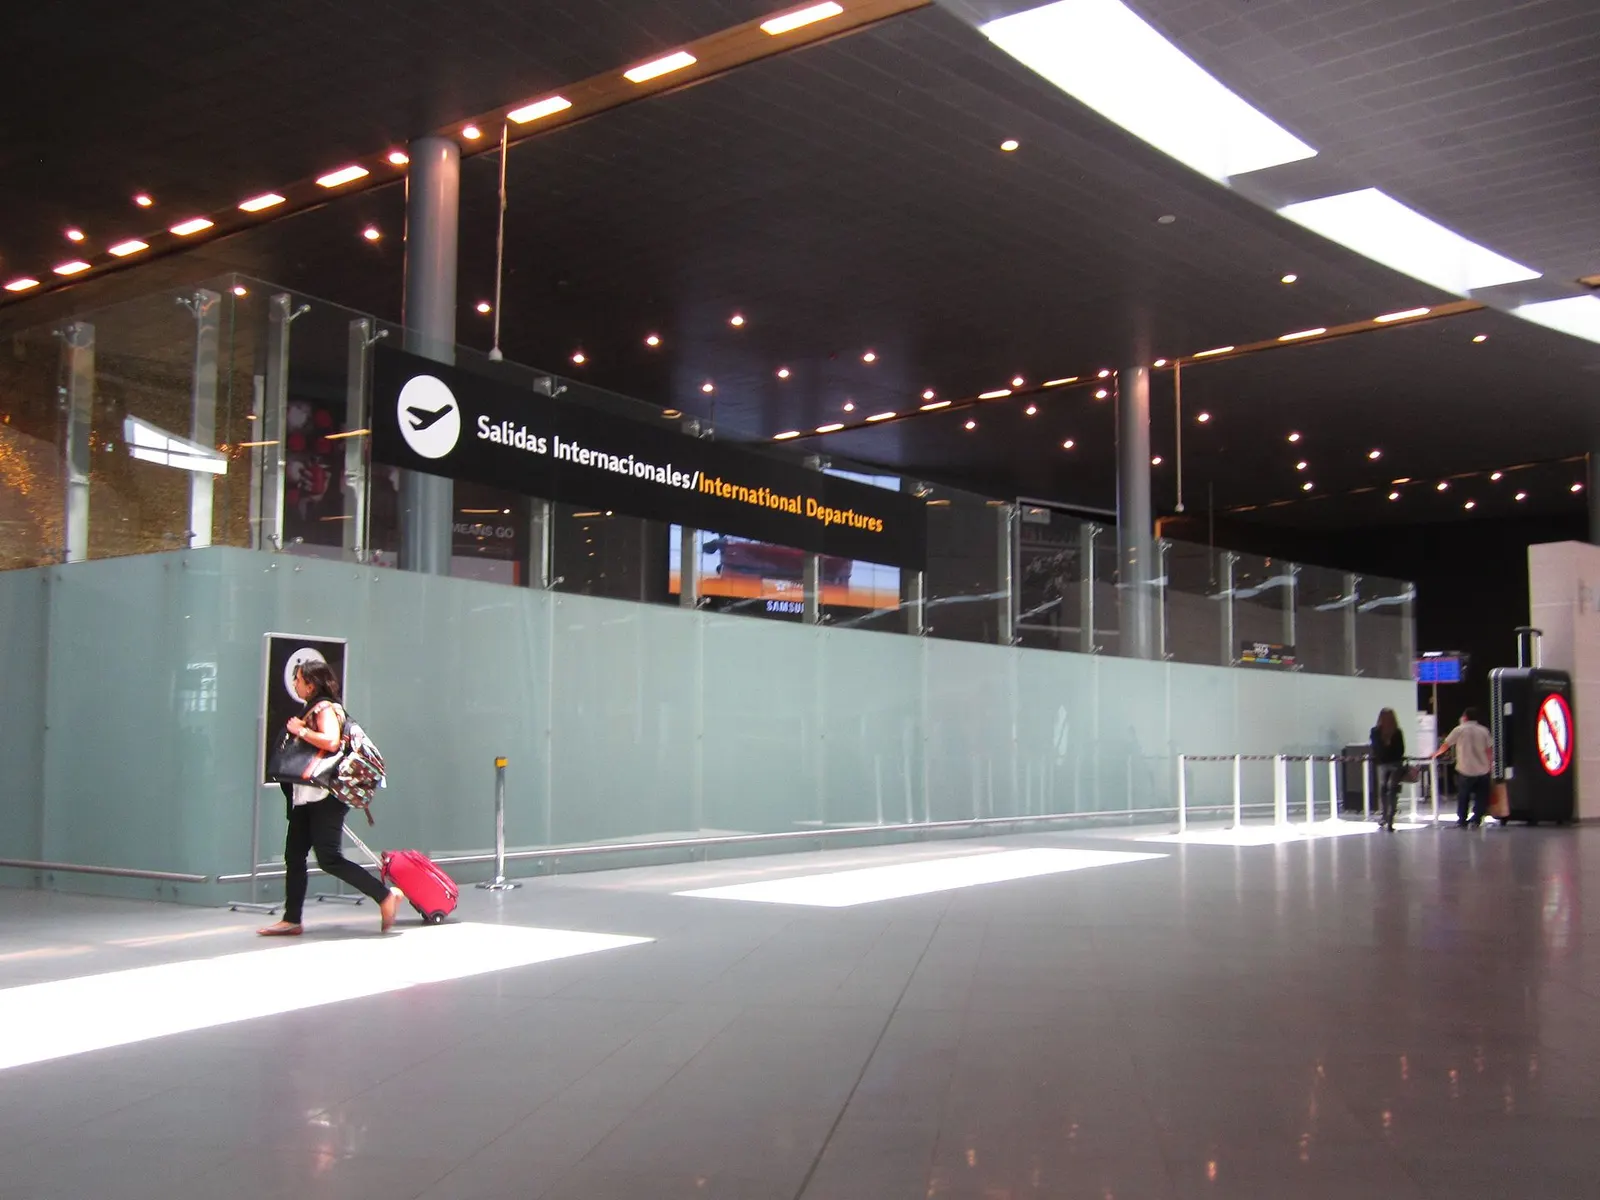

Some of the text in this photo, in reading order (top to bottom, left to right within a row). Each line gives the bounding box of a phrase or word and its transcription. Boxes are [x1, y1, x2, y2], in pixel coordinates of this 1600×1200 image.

[477, 415, 547, 455] Salidas
[806, 498, 884, 533] Departures
[495, 526, 515, 539] GO
